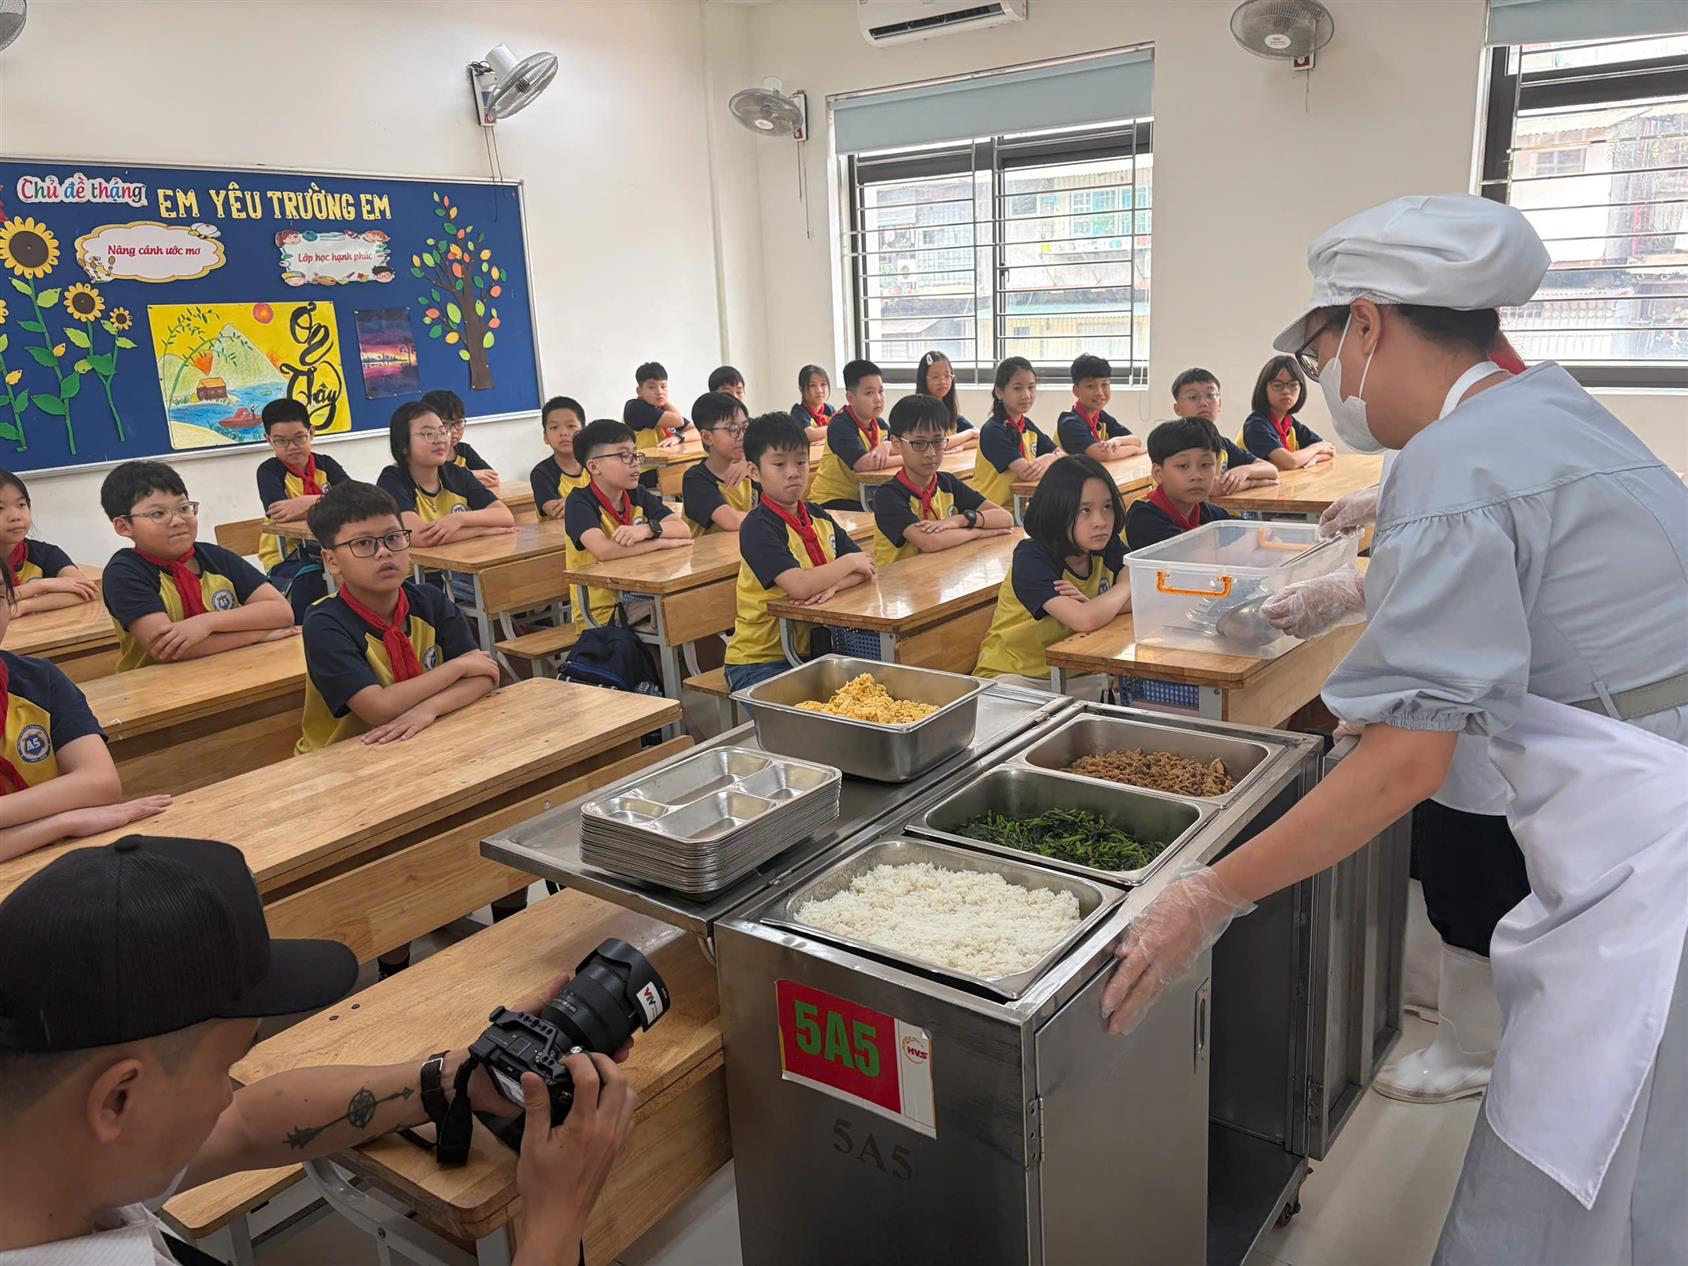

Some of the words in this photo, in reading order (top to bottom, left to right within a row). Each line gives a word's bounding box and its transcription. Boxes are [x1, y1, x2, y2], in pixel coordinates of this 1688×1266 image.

[21, 178, 60, 200] Chủ
[64, 176, 86, 200] đề
[91, 180, 143, 204] tháng
[157, 188, 200, 218] EM
[209, 181, 263, 220] YÊU
[267, 182, 356, 221] TRƯỜNG
[360, 193, 392, 220] EM
[138, 245, 163, 256] cánh
[298, 252, 314, 264] Lớp
[315, 252, 330, 264] học
[332, 252, 352, 263] hạnh
[354, 251, 374, 262] phúc
[25, 737, 42, 752] A5
[794, 1000, 881, 1077] 5A5
[832, 1118, 913, 1181] 5A5
